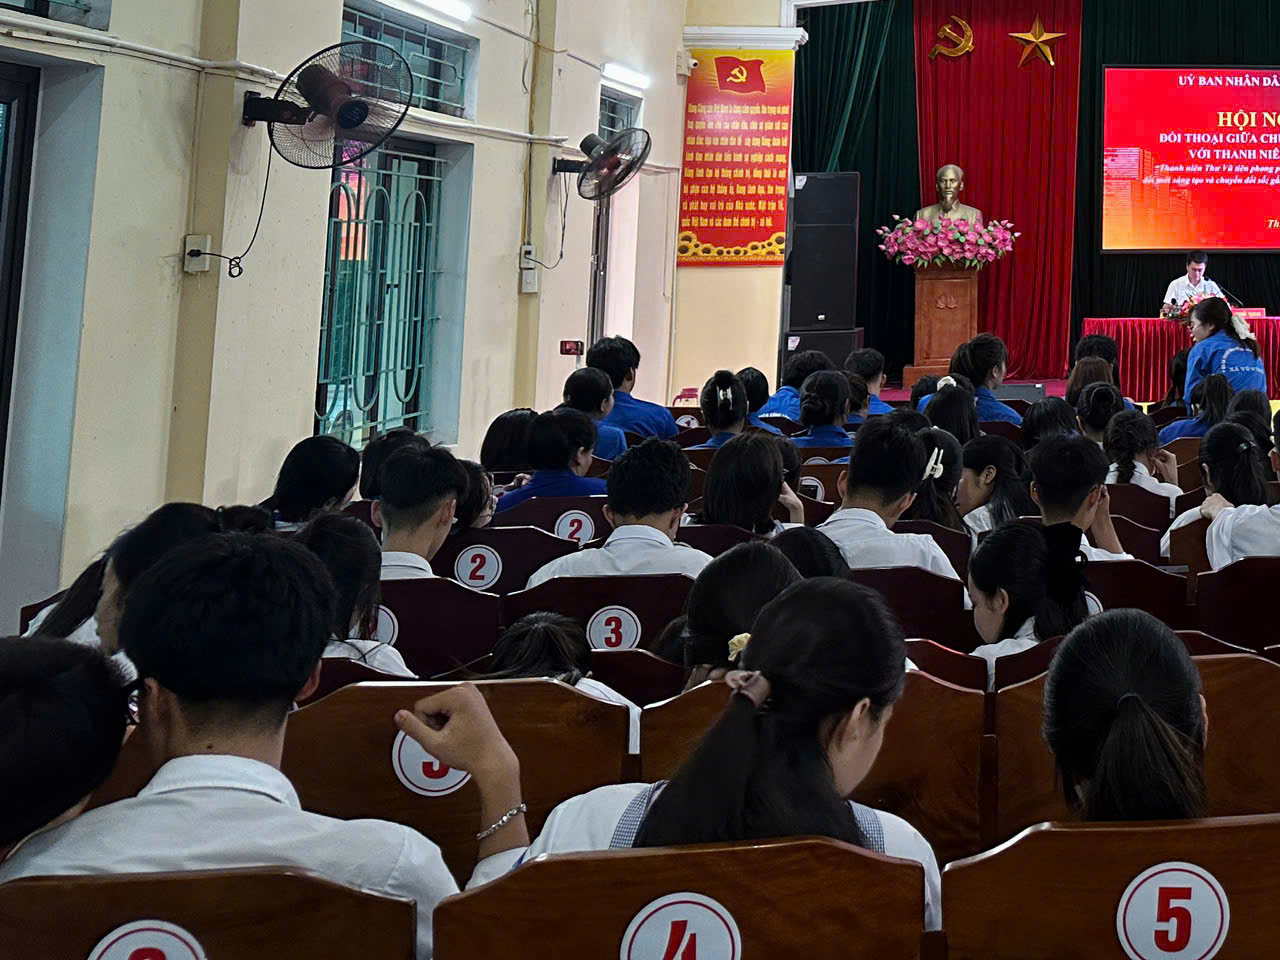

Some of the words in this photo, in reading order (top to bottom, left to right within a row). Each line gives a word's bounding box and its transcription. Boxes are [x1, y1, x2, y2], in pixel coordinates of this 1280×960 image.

[1198, 76, 1225, 86] BAN
[1226, 74, 1260, 86] NHÂN
[1217, 109, 1257, 131] HỘI
[1185, 133, 1223, 145] THOẠI
[1226, 131, 1258, 143] GIỮA
[1189, 148, 1210, 159] VỚI
[1214, 149, 1257, 160] THANH
[568, 518, 582, 542] 2
[468, 553, 487, 581] 2
[604, 616, 622, 648] 3
[1154, 886, 1192, 952] 5
[662, 920, 697, 960] 4
